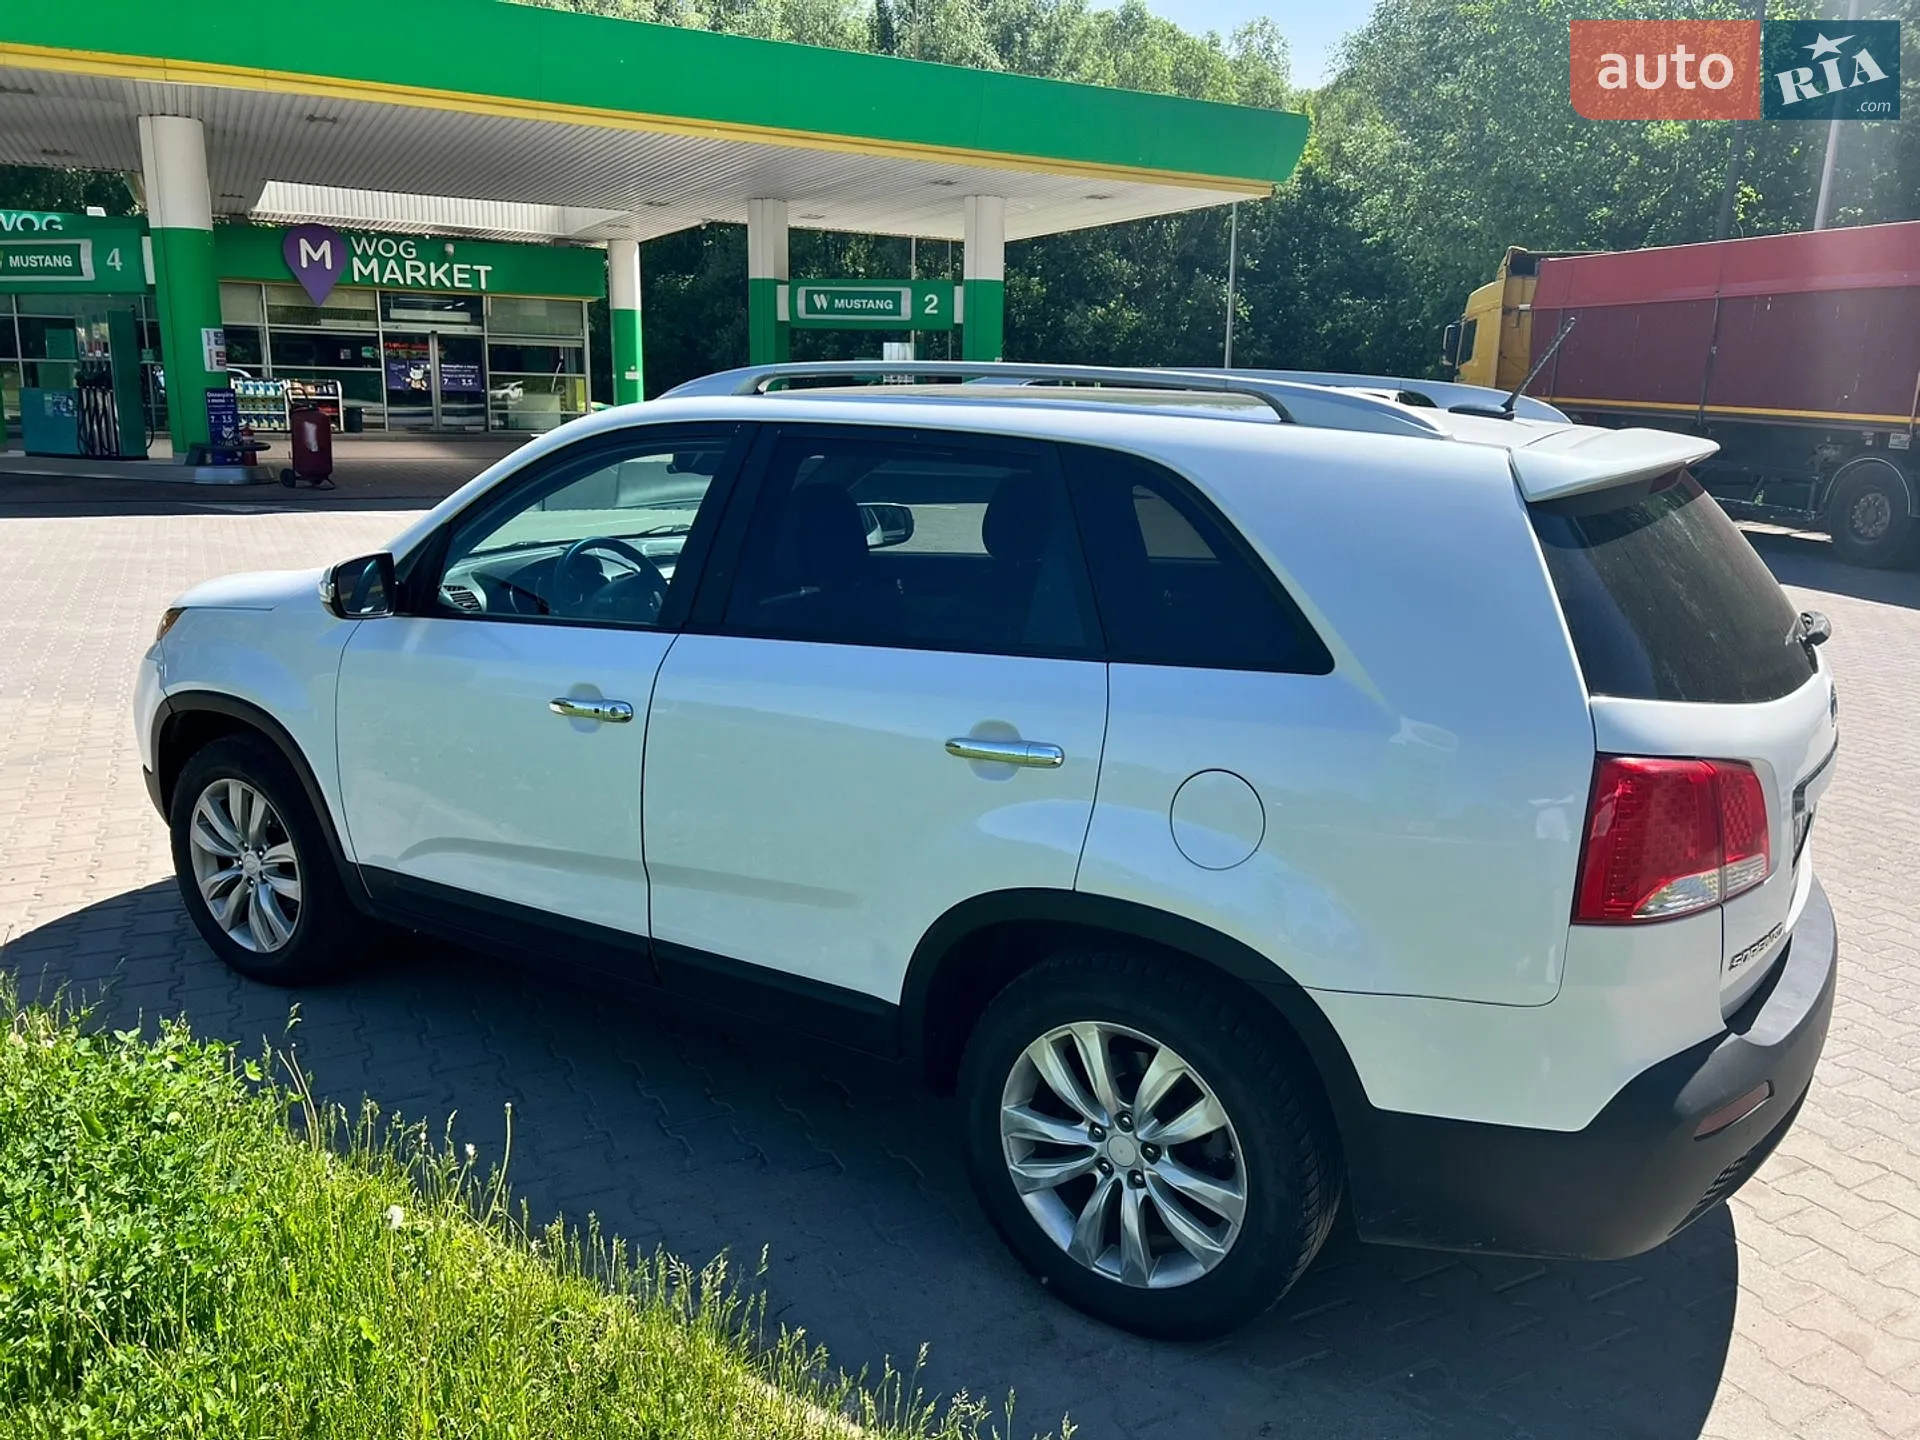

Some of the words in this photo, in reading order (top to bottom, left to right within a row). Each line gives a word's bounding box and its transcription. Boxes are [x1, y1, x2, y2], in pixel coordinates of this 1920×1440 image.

[299, 237, 333, 270] M
[350, 236, 417, 259] WOG
[9, 255, 73, 268] MUSTANG
[106, 247, 123, 272] 4
[352, 257, 493, 290] MARKET
[834, 298, 894, 310] MUSTANG
[923, 294, 939, 314] 2
